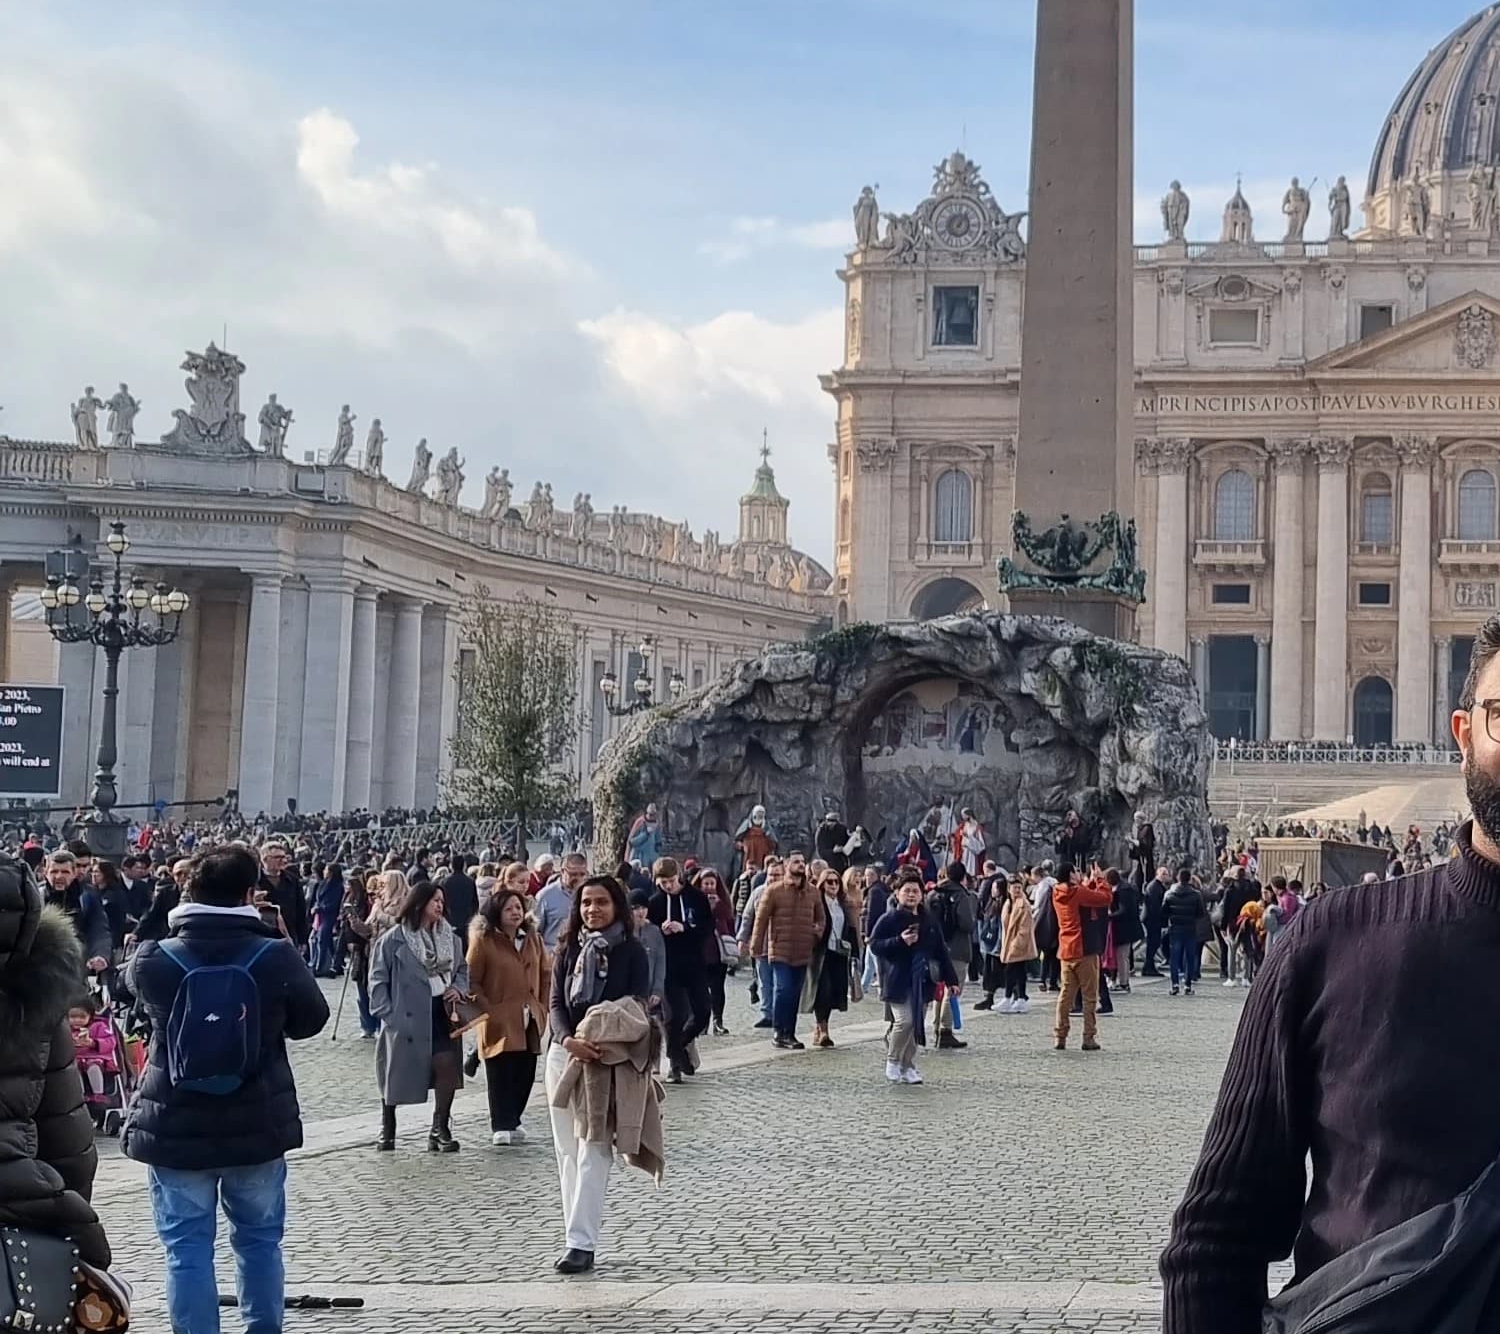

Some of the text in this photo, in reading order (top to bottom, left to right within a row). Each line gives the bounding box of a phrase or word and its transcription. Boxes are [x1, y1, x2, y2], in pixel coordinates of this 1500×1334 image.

[1159, 396, 1256, 412] PRINCIPIS
[1260, 395, 1317, 412] APOST
[1321, 395, 1386, 410] PAVLVS
[3, 756, 21, 766] will
